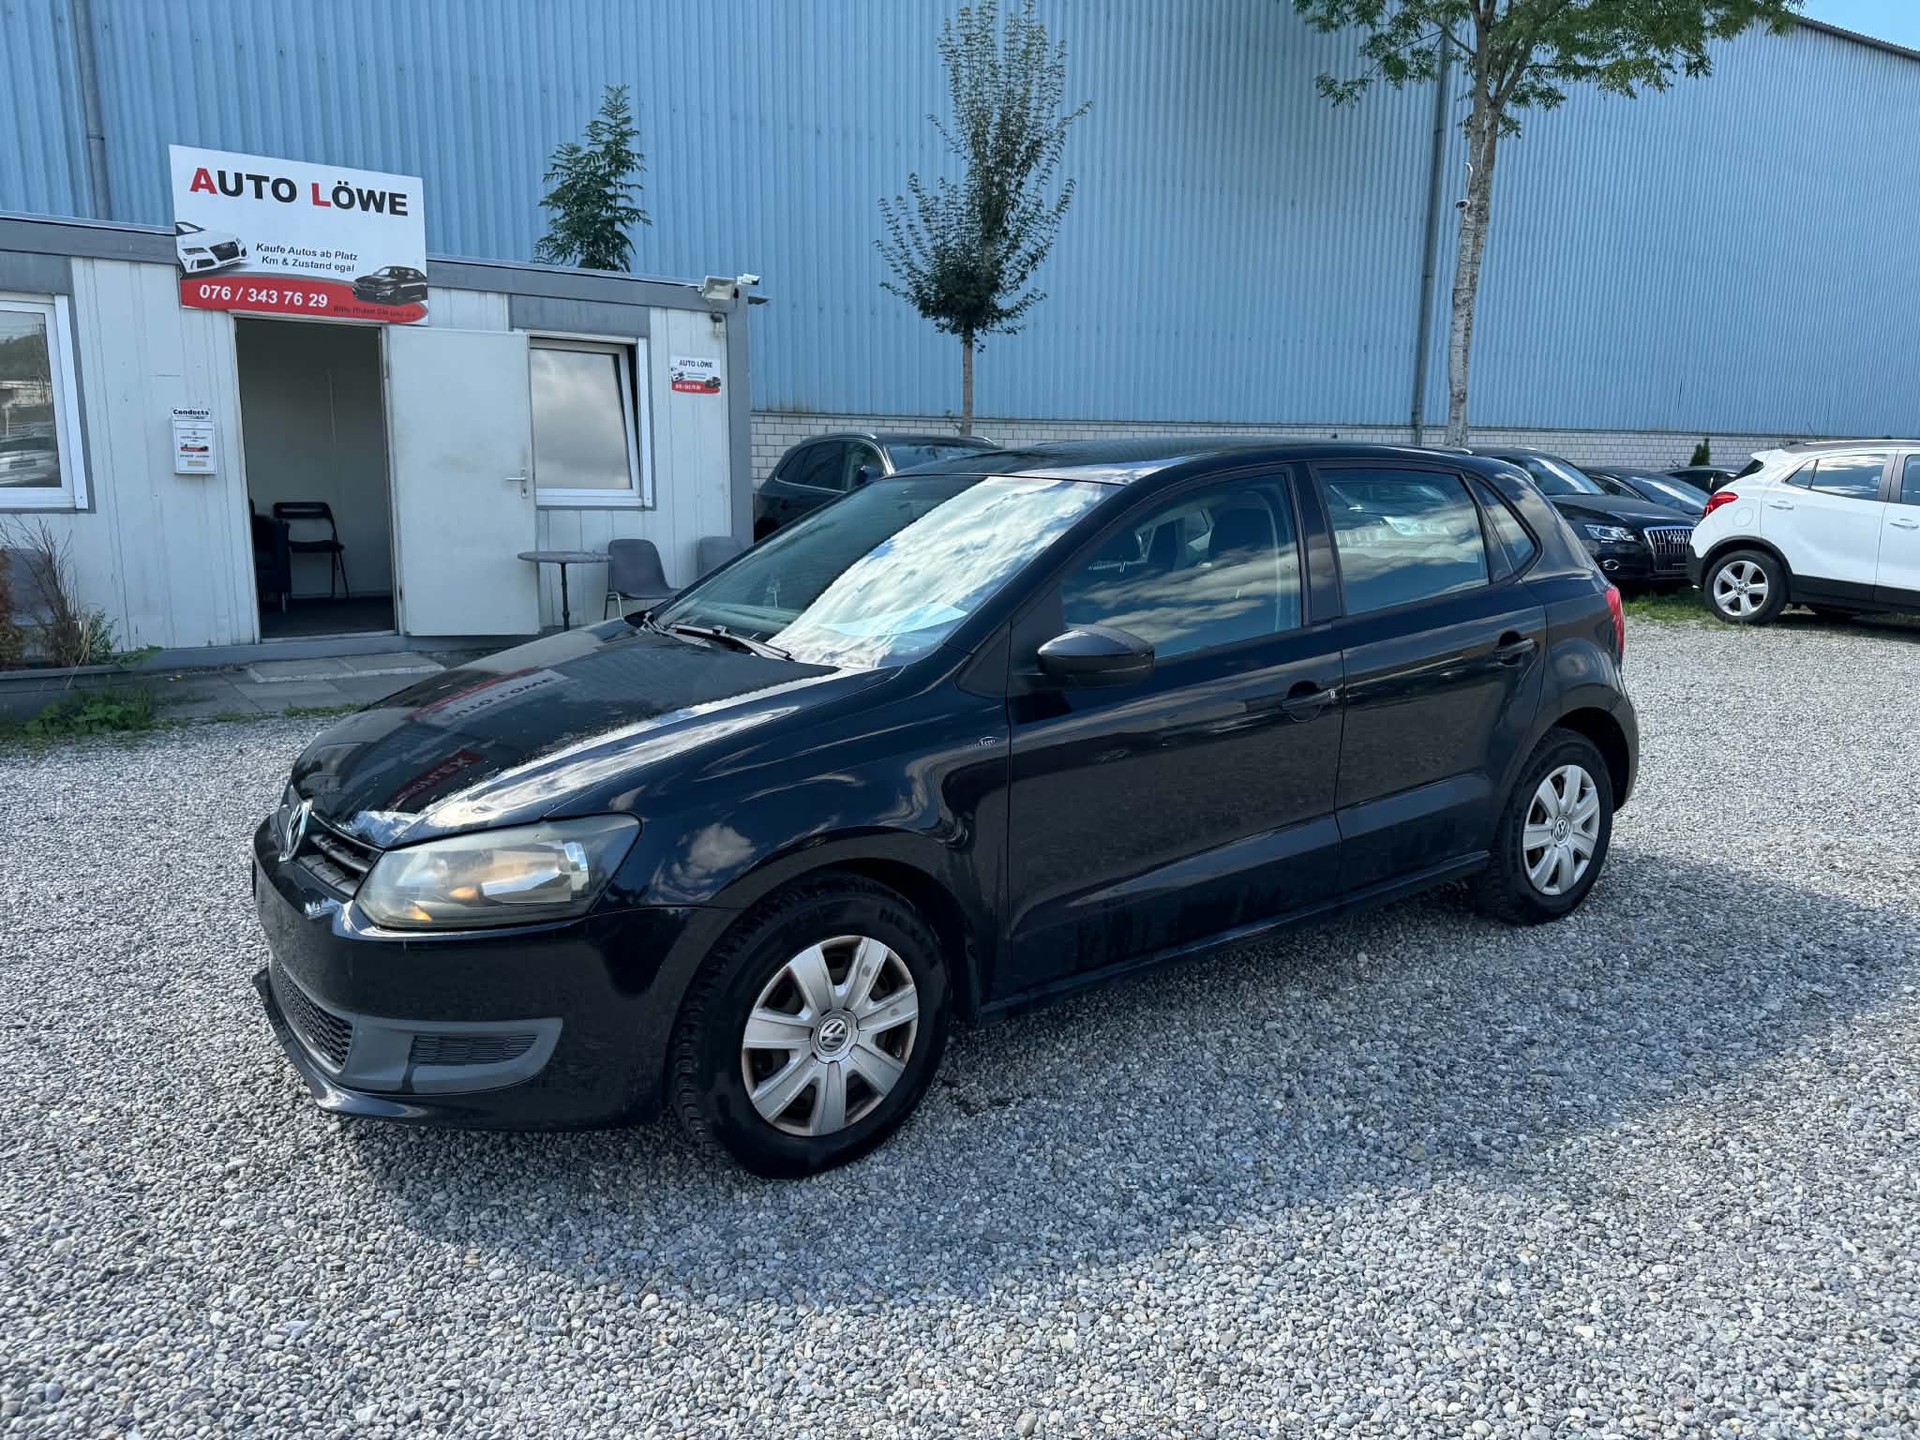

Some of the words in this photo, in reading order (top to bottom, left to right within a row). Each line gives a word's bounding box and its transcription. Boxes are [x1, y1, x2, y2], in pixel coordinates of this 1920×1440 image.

[190, 167, 297, 203] AUTO
[311, 180, 408, 217] LÖWE
[255, 242, 286, 255] Kaufe
[287, 246, 317, 257] Autos
[320, 249, 332, 258] ab
[334, 250, 358, 261] Platz
[261, 255, 278, 266] Km
[281, 257, 289, 266] &
[292, 258, 332, 270] Zustand
[334, 264, 354, 273] egal
[199, 284, 231, 300] 076
[235, 287, 244, 301] /
[247, 288, 278, 304] 343
[283, 291, 303, 306] 76
[308, 293, 328, 308] 29
[679, 359, 696, 367] AUTO
